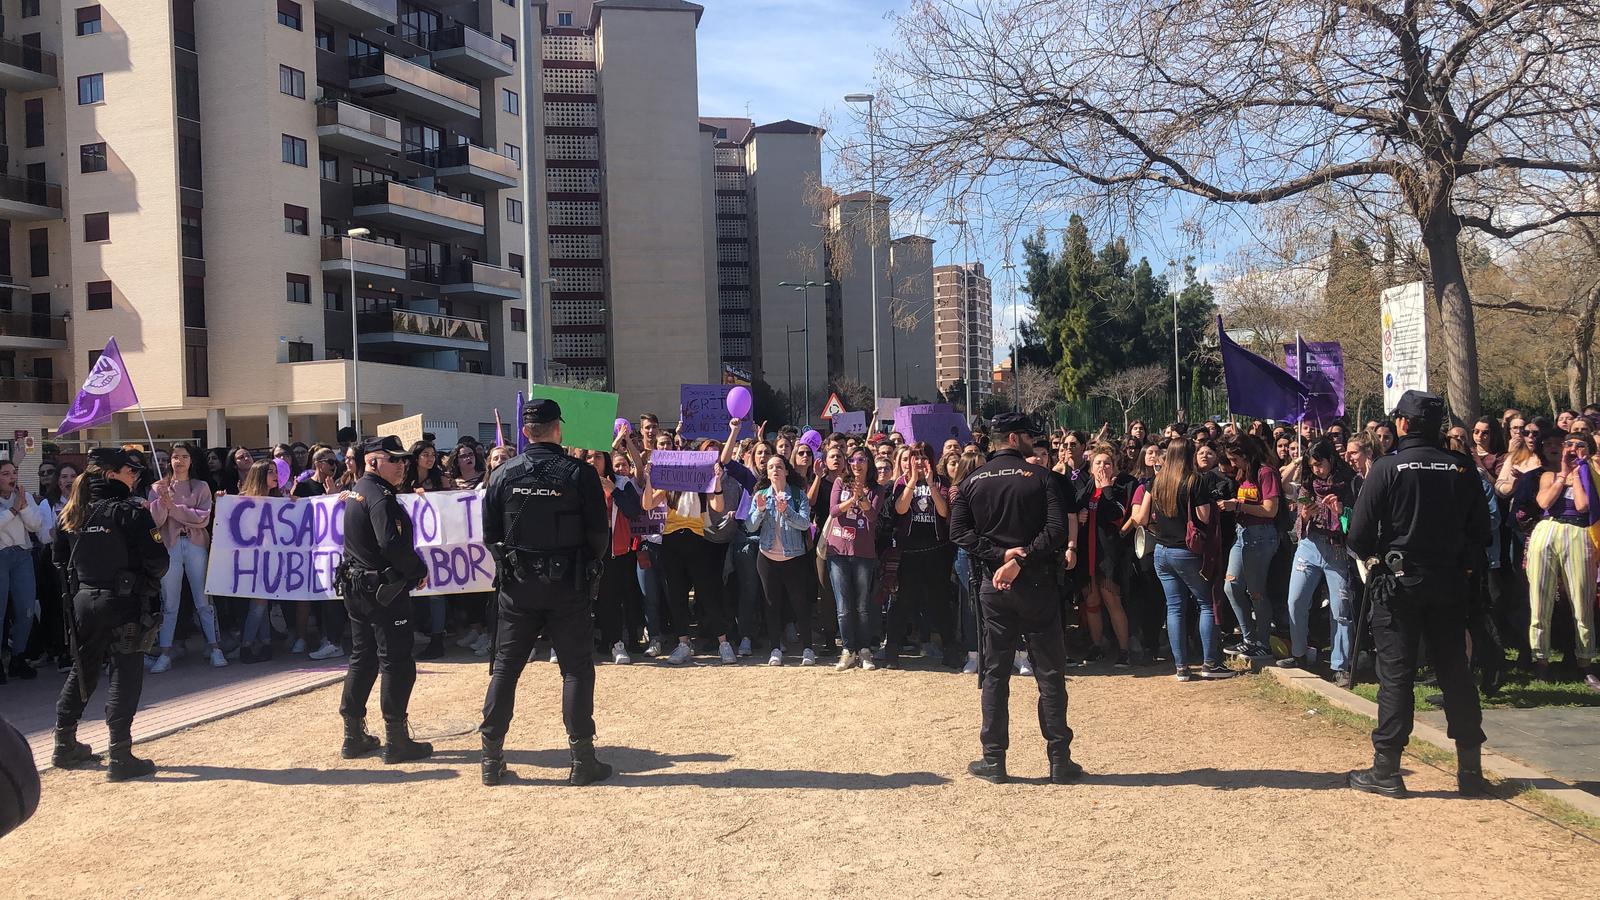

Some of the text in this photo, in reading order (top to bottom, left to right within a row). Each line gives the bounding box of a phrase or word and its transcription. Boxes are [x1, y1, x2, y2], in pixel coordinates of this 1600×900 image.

[1397, 462, 1458, 472] POLICIA
[970, 468, 1024, 484] POLICIA
[513, 487, 557, 497] POLICIA
